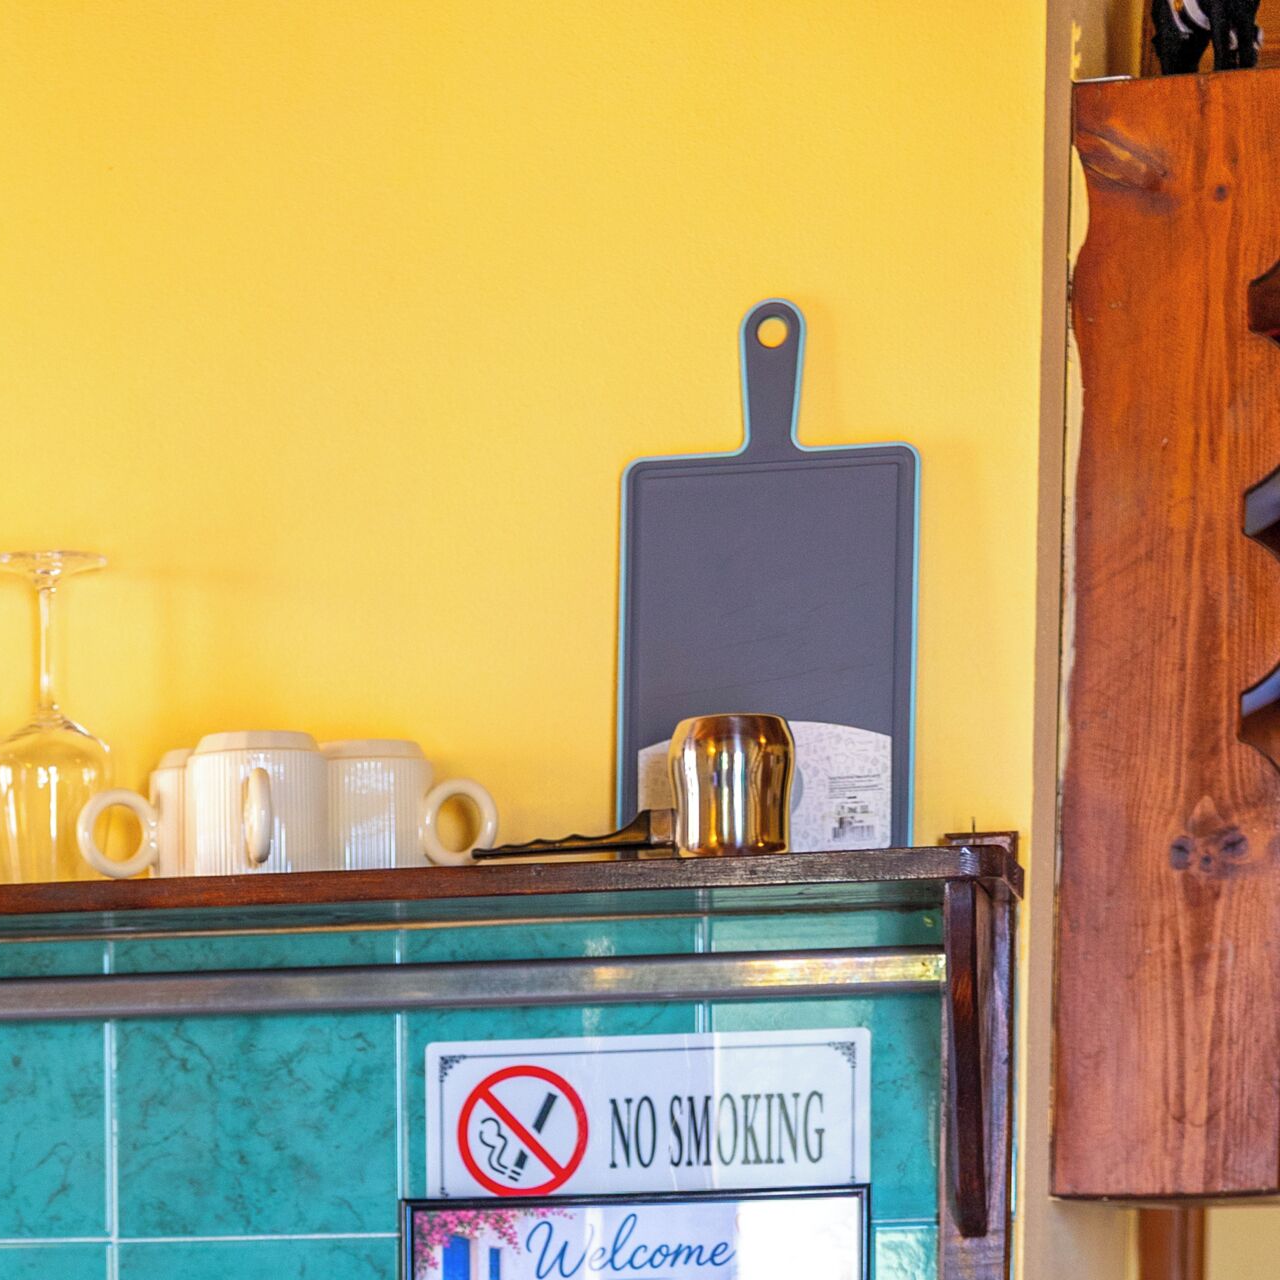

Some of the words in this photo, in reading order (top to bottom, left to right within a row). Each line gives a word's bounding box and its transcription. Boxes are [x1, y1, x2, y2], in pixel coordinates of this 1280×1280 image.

[609, 1095, 657, 1169] NO
[669, 1090, 825, 1168] SMOKING
[525, 1213, 737, 1280] Welcome
